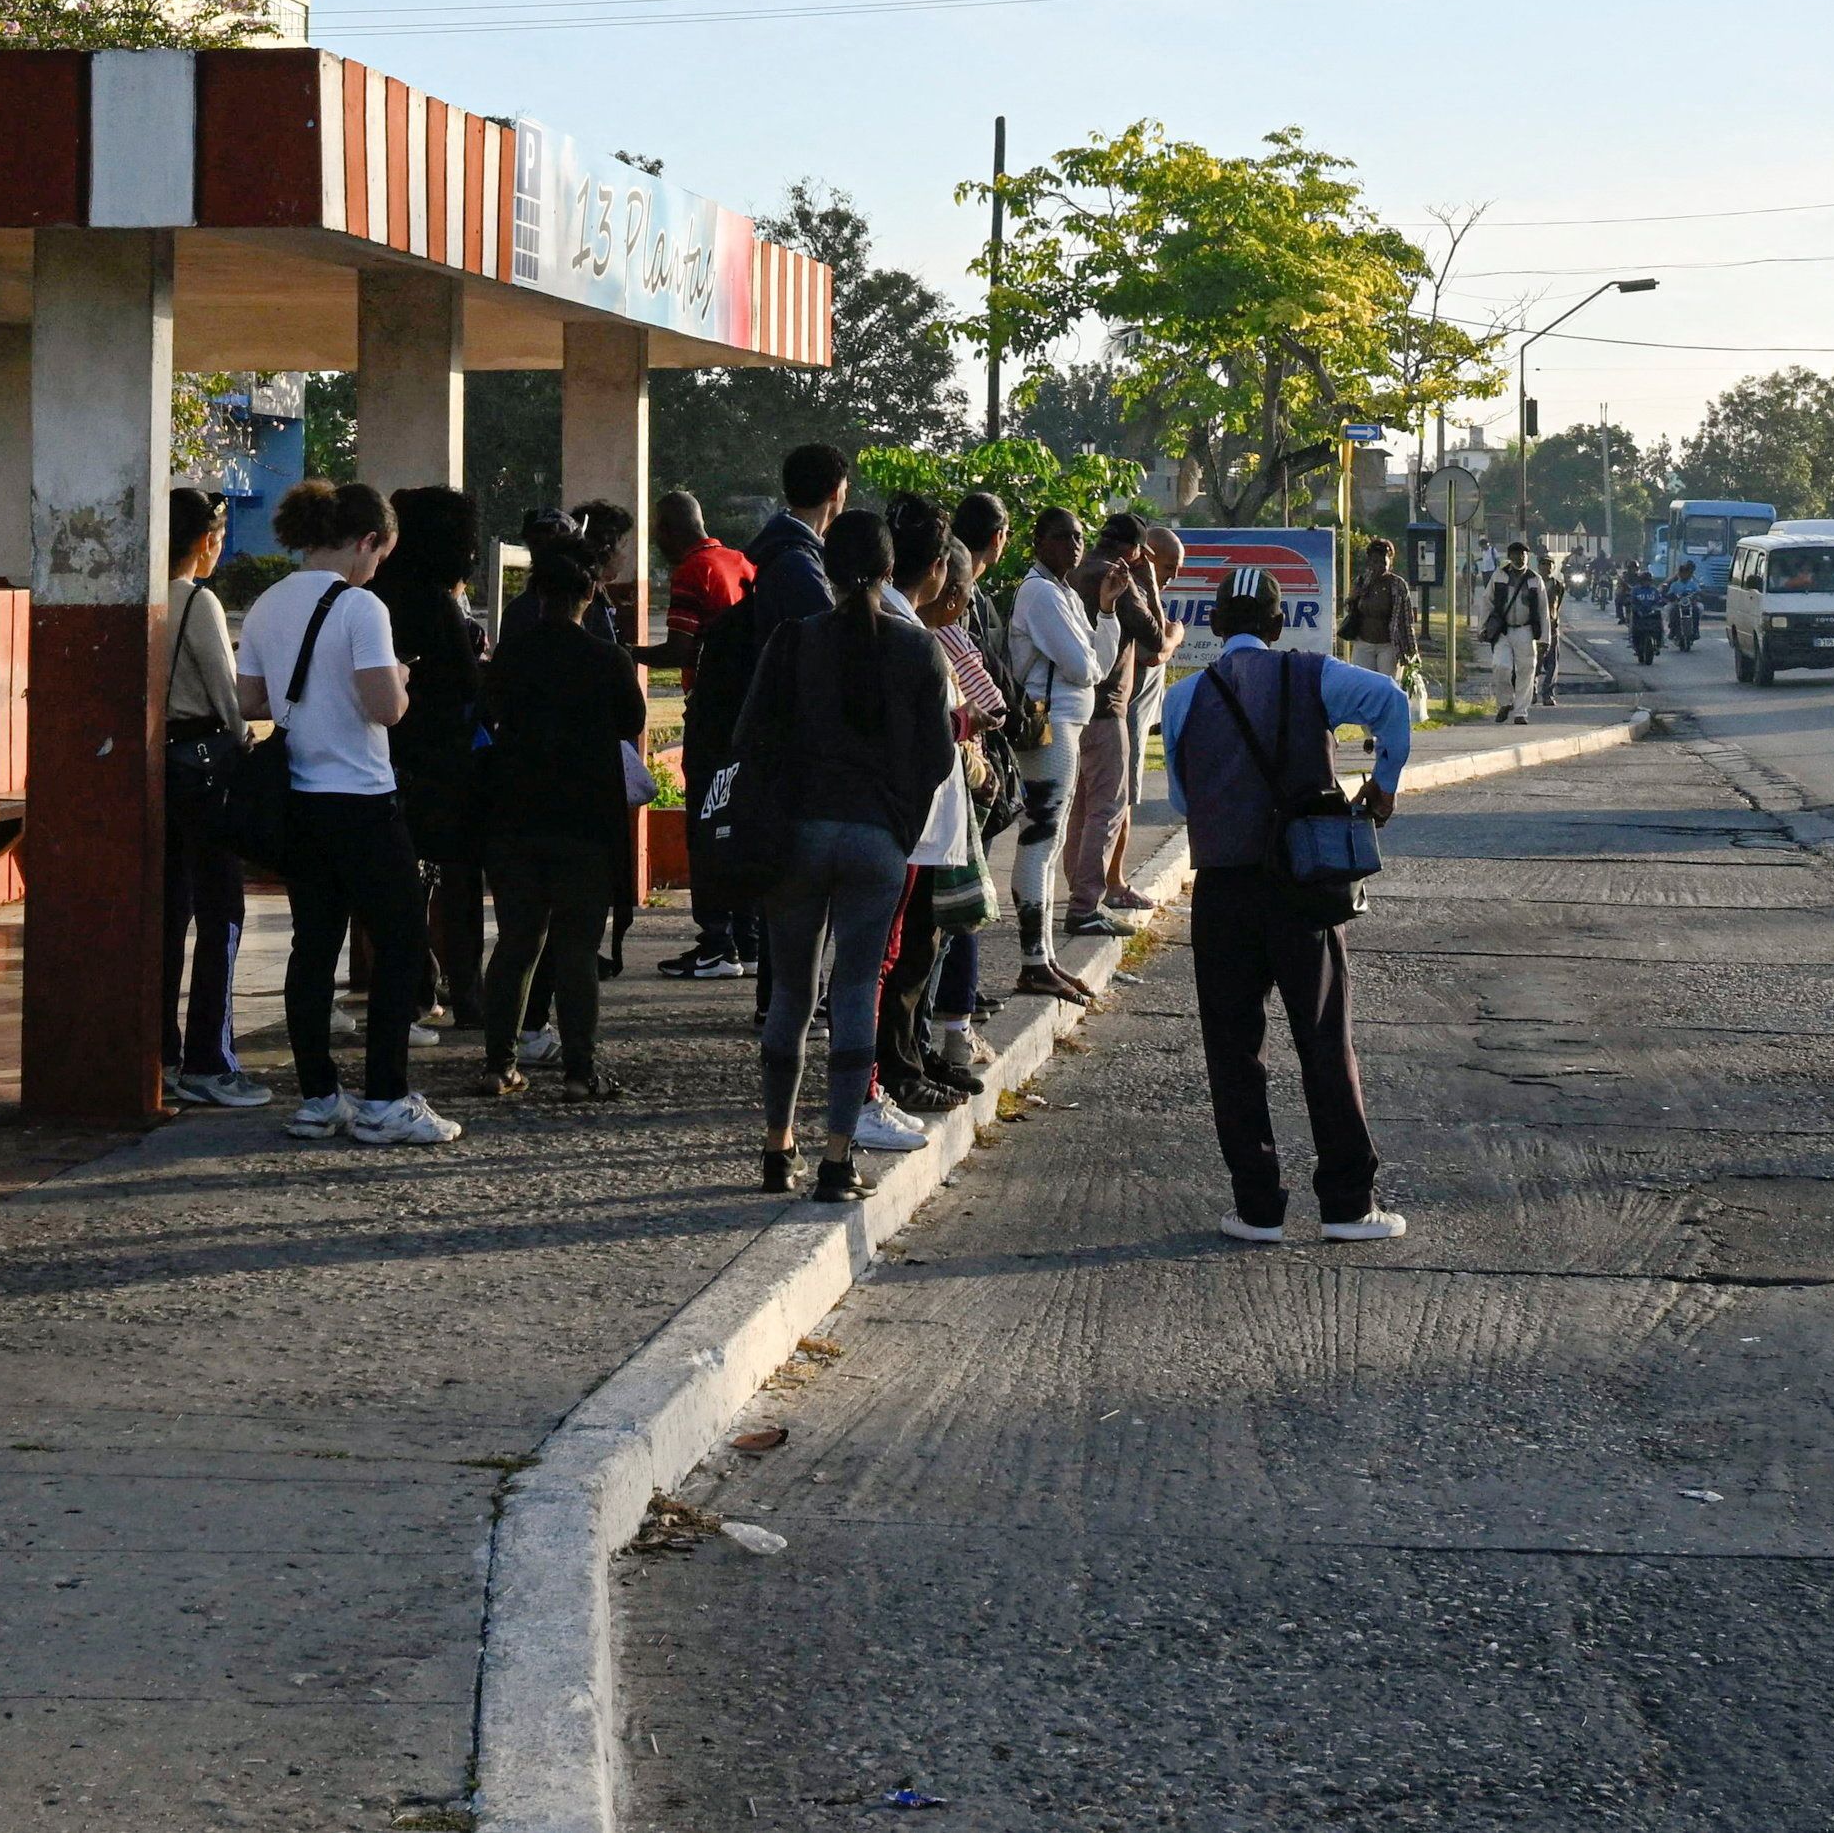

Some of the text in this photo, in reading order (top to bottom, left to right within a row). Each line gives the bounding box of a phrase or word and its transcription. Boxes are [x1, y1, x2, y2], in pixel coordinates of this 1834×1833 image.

[524, 131, 536, 190] P
[571, 174, 717, 324] 13 Plantas
[1193, 640, 1212, 649] JEEP
